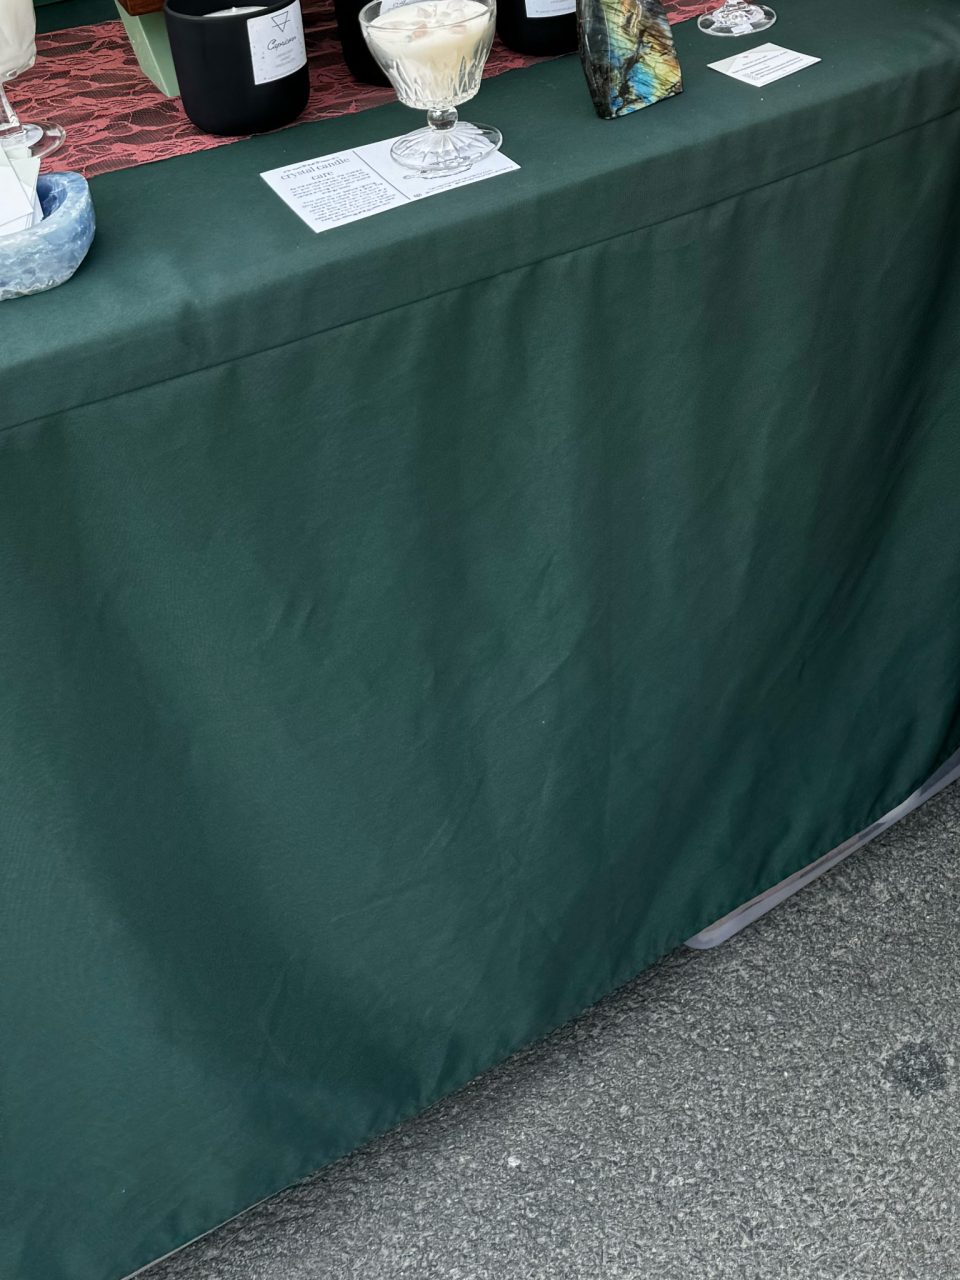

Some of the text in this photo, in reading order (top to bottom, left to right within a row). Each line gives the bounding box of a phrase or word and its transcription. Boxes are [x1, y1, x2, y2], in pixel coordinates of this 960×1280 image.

[267, 34, 298, 51] Capricorn
[280, 164, 316, 183] crystal
[315, 156, 351, 173] candle
[310, 170, 335, 182] care
